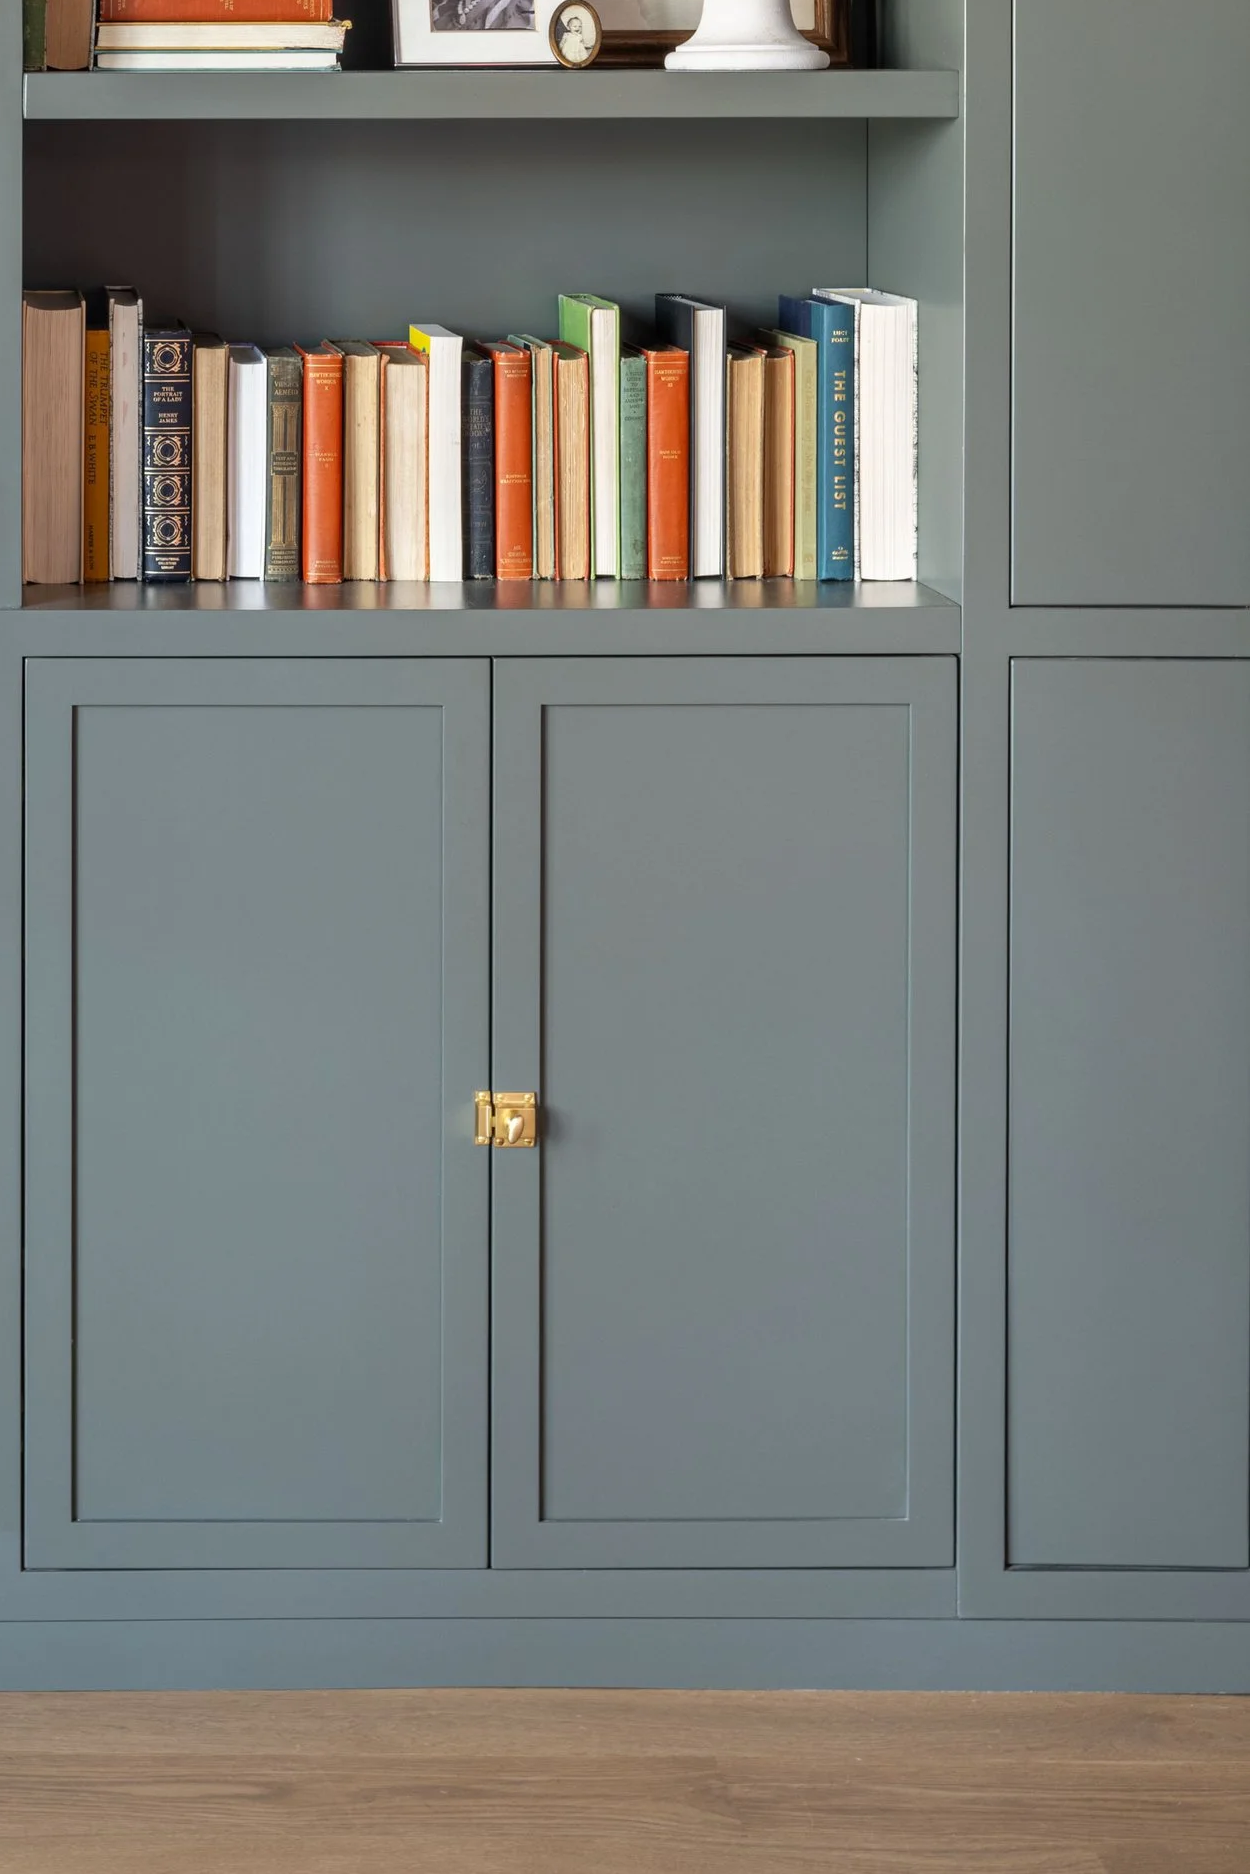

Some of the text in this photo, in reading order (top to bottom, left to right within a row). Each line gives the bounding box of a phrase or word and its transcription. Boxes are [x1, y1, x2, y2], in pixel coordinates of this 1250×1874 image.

[90, 352, 98, 365] OF
[88, 391, 98, 425] SWAN
[100, 352, 108, 426] THE TRUMPET
[834, 371, 846, 510] THE GUEST LIST
